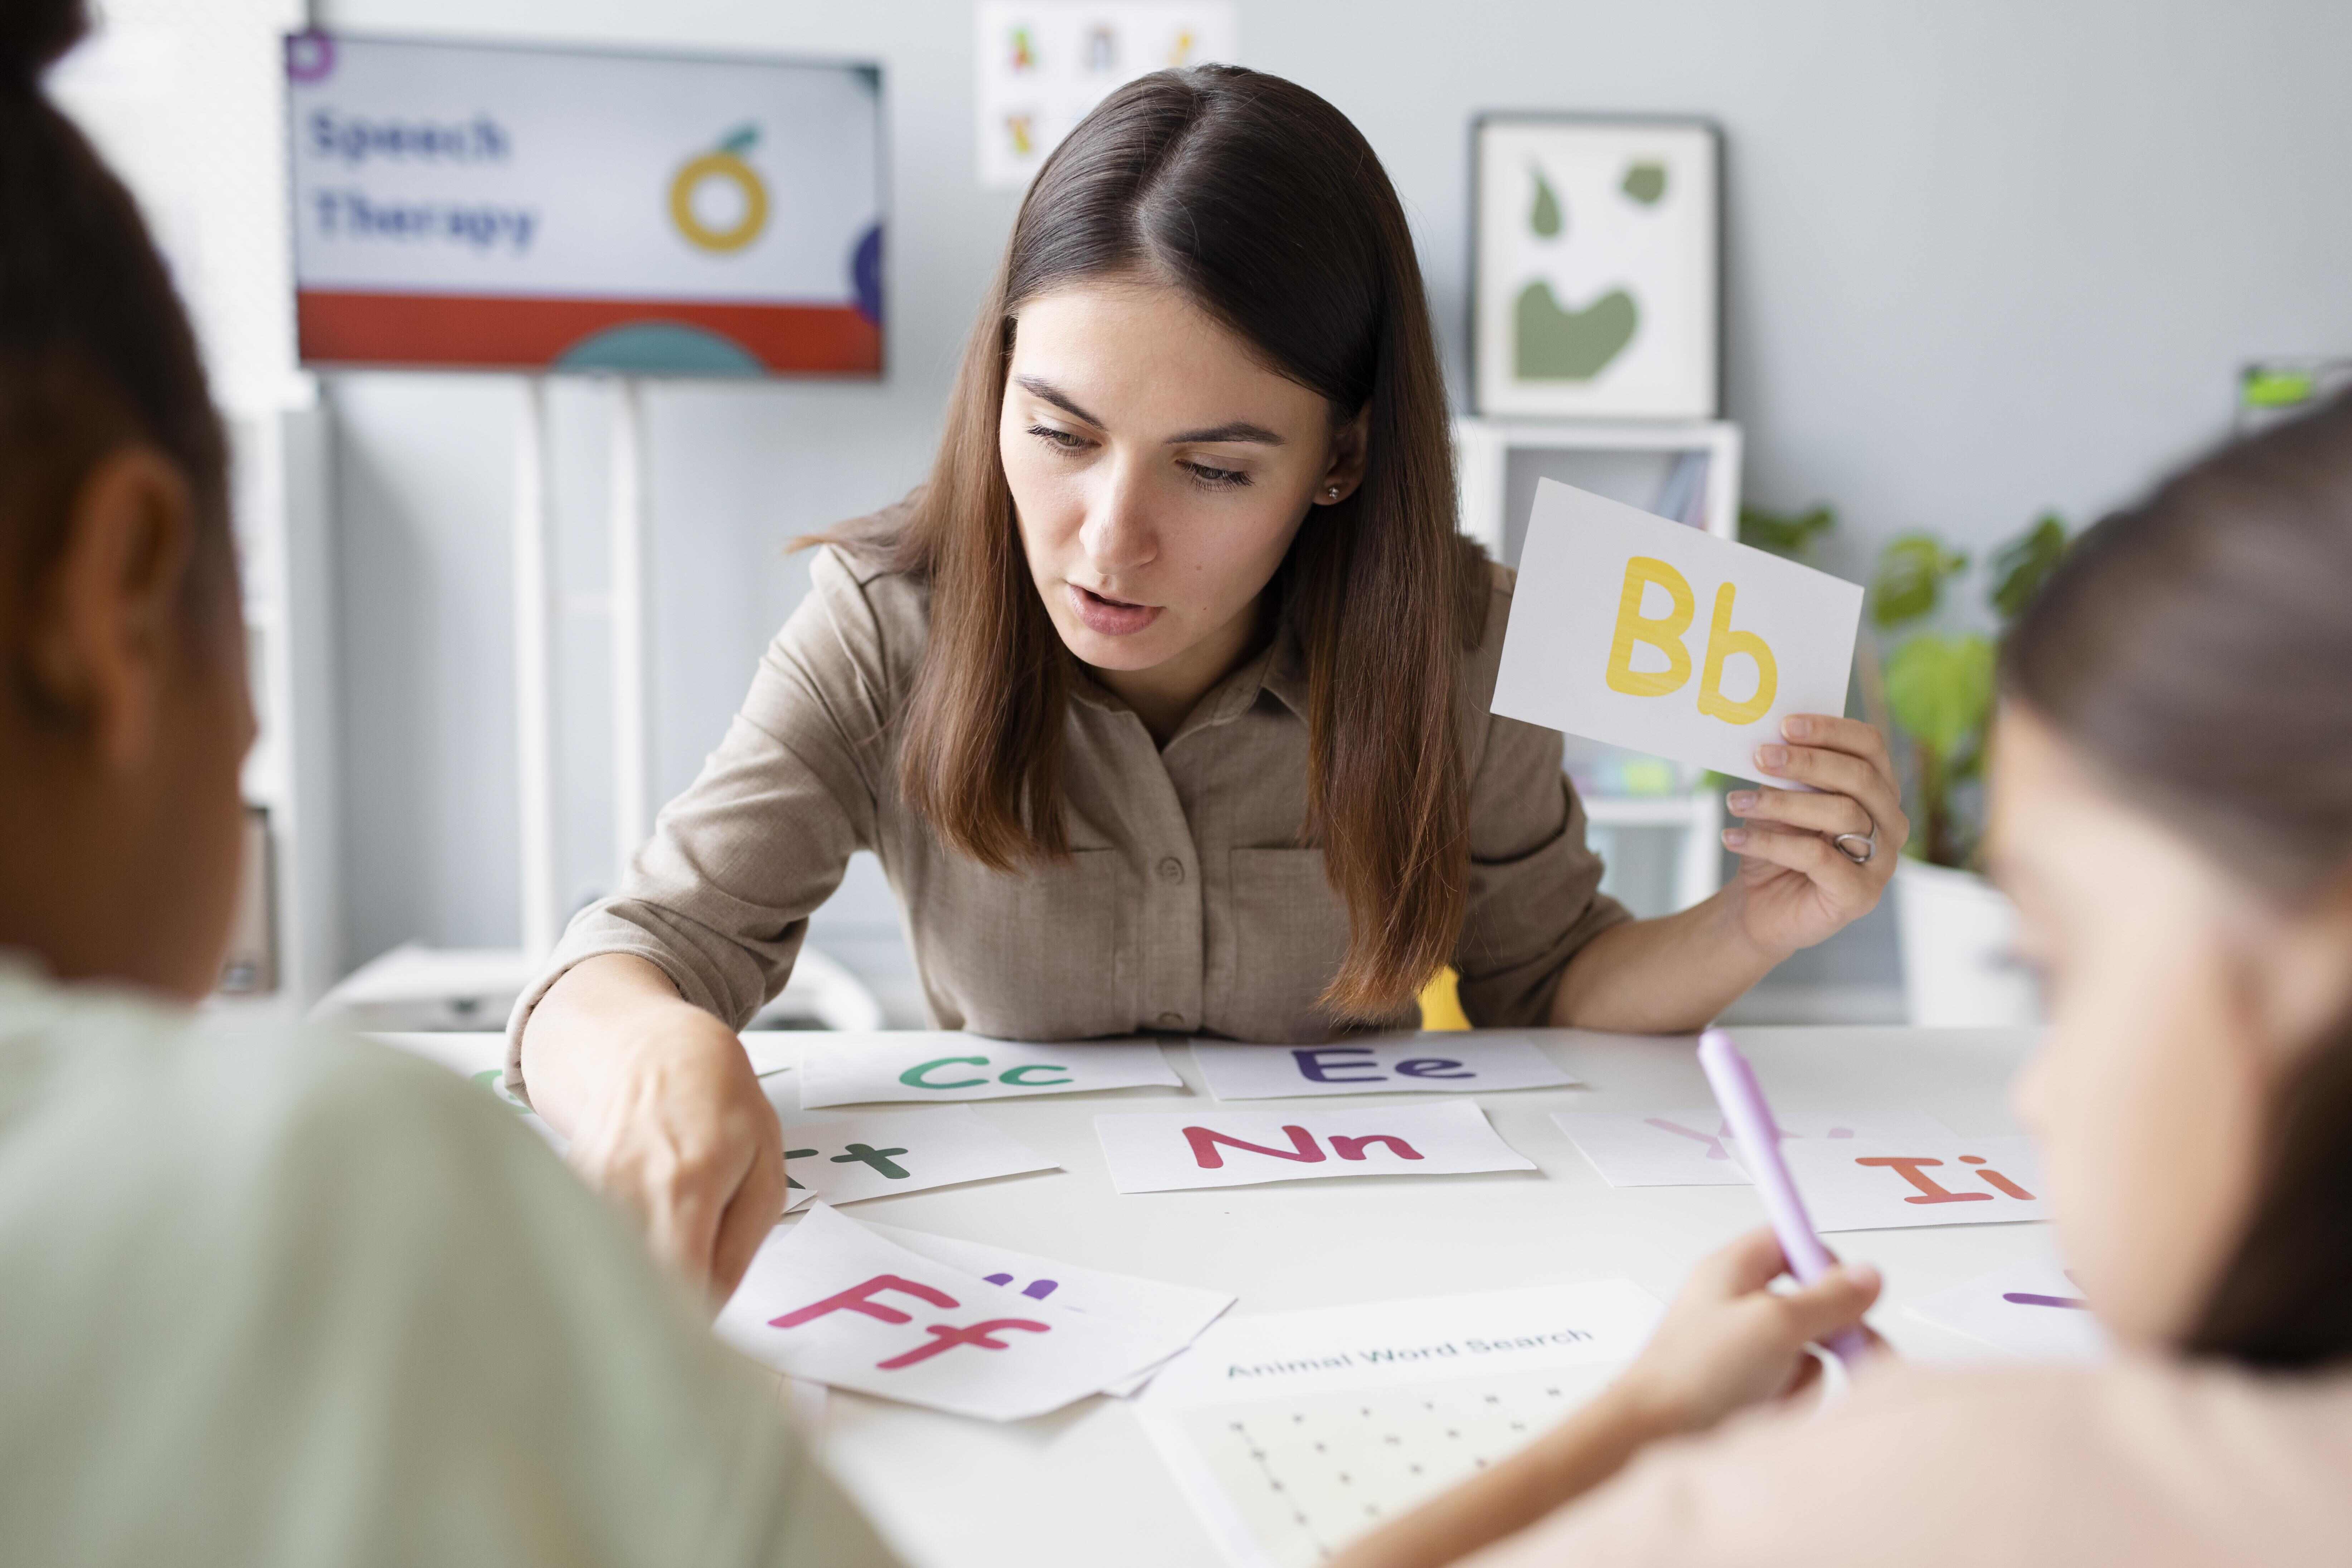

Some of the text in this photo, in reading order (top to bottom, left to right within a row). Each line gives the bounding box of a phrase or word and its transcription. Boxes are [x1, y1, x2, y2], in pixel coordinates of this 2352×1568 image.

[310, 108, 512, 167] Speech
[312, 190, 540, 256] Therapy
[1605, 555, 1778, 725] Bb
[899, 1056, 1074, 1089] Cc
[1291, 1048, 1477, 1083] Ee
[1182, 1125, 1425, 1169] Nn
[1855, 1154, 2037, 1204] Ii
[767, 1274, 1051, 1370] Ff
[1227, 1327, 1594, 1379] Animal Word Search
